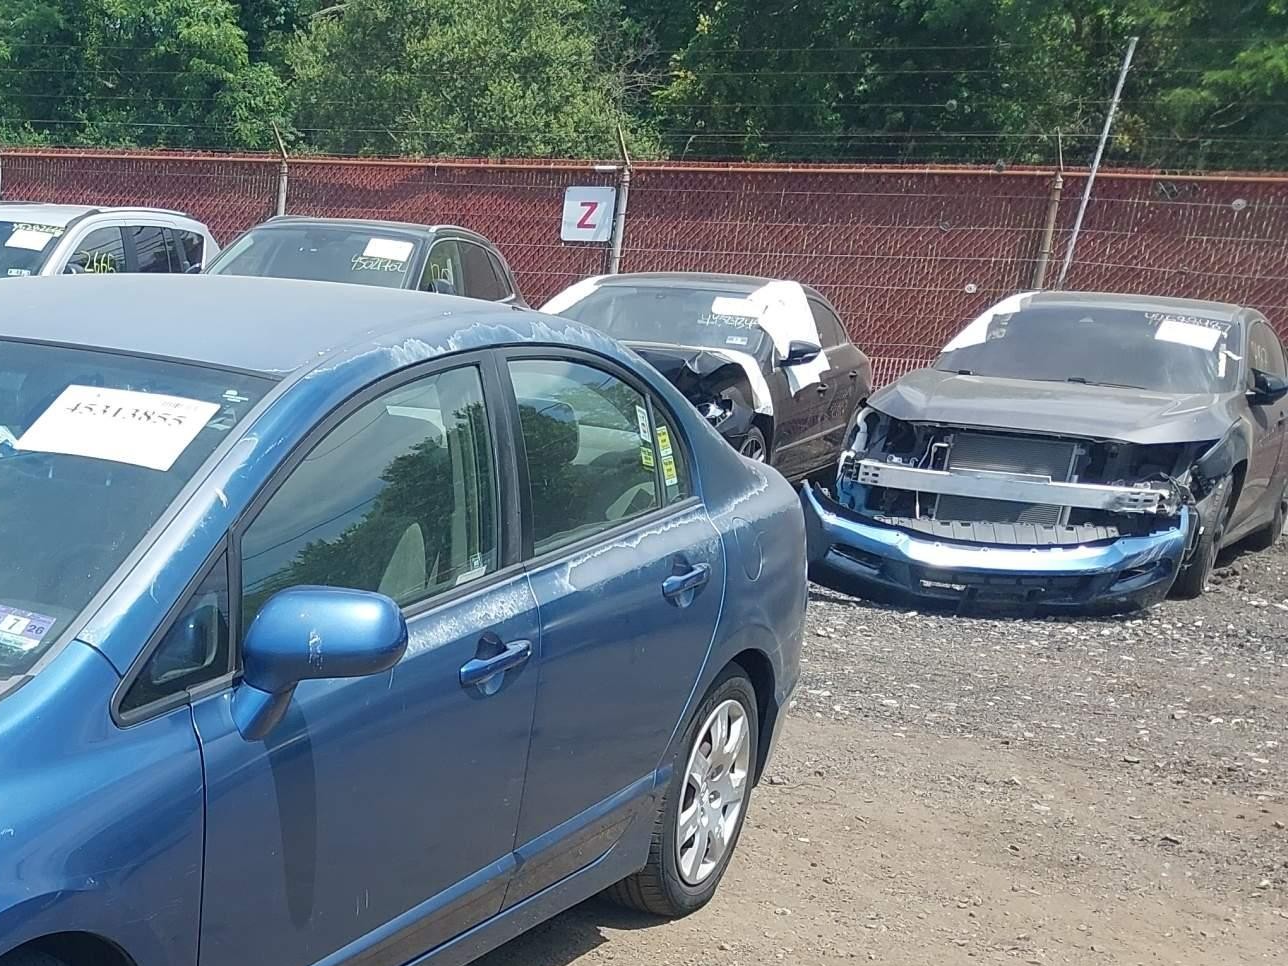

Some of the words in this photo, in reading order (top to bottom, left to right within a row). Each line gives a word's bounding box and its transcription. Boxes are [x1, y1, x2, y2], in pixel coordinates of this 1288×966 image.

[577, 202, 598, 228] Z
[65, 402, 188, 426] 45313855
[8, 618, 21, 630] 7
